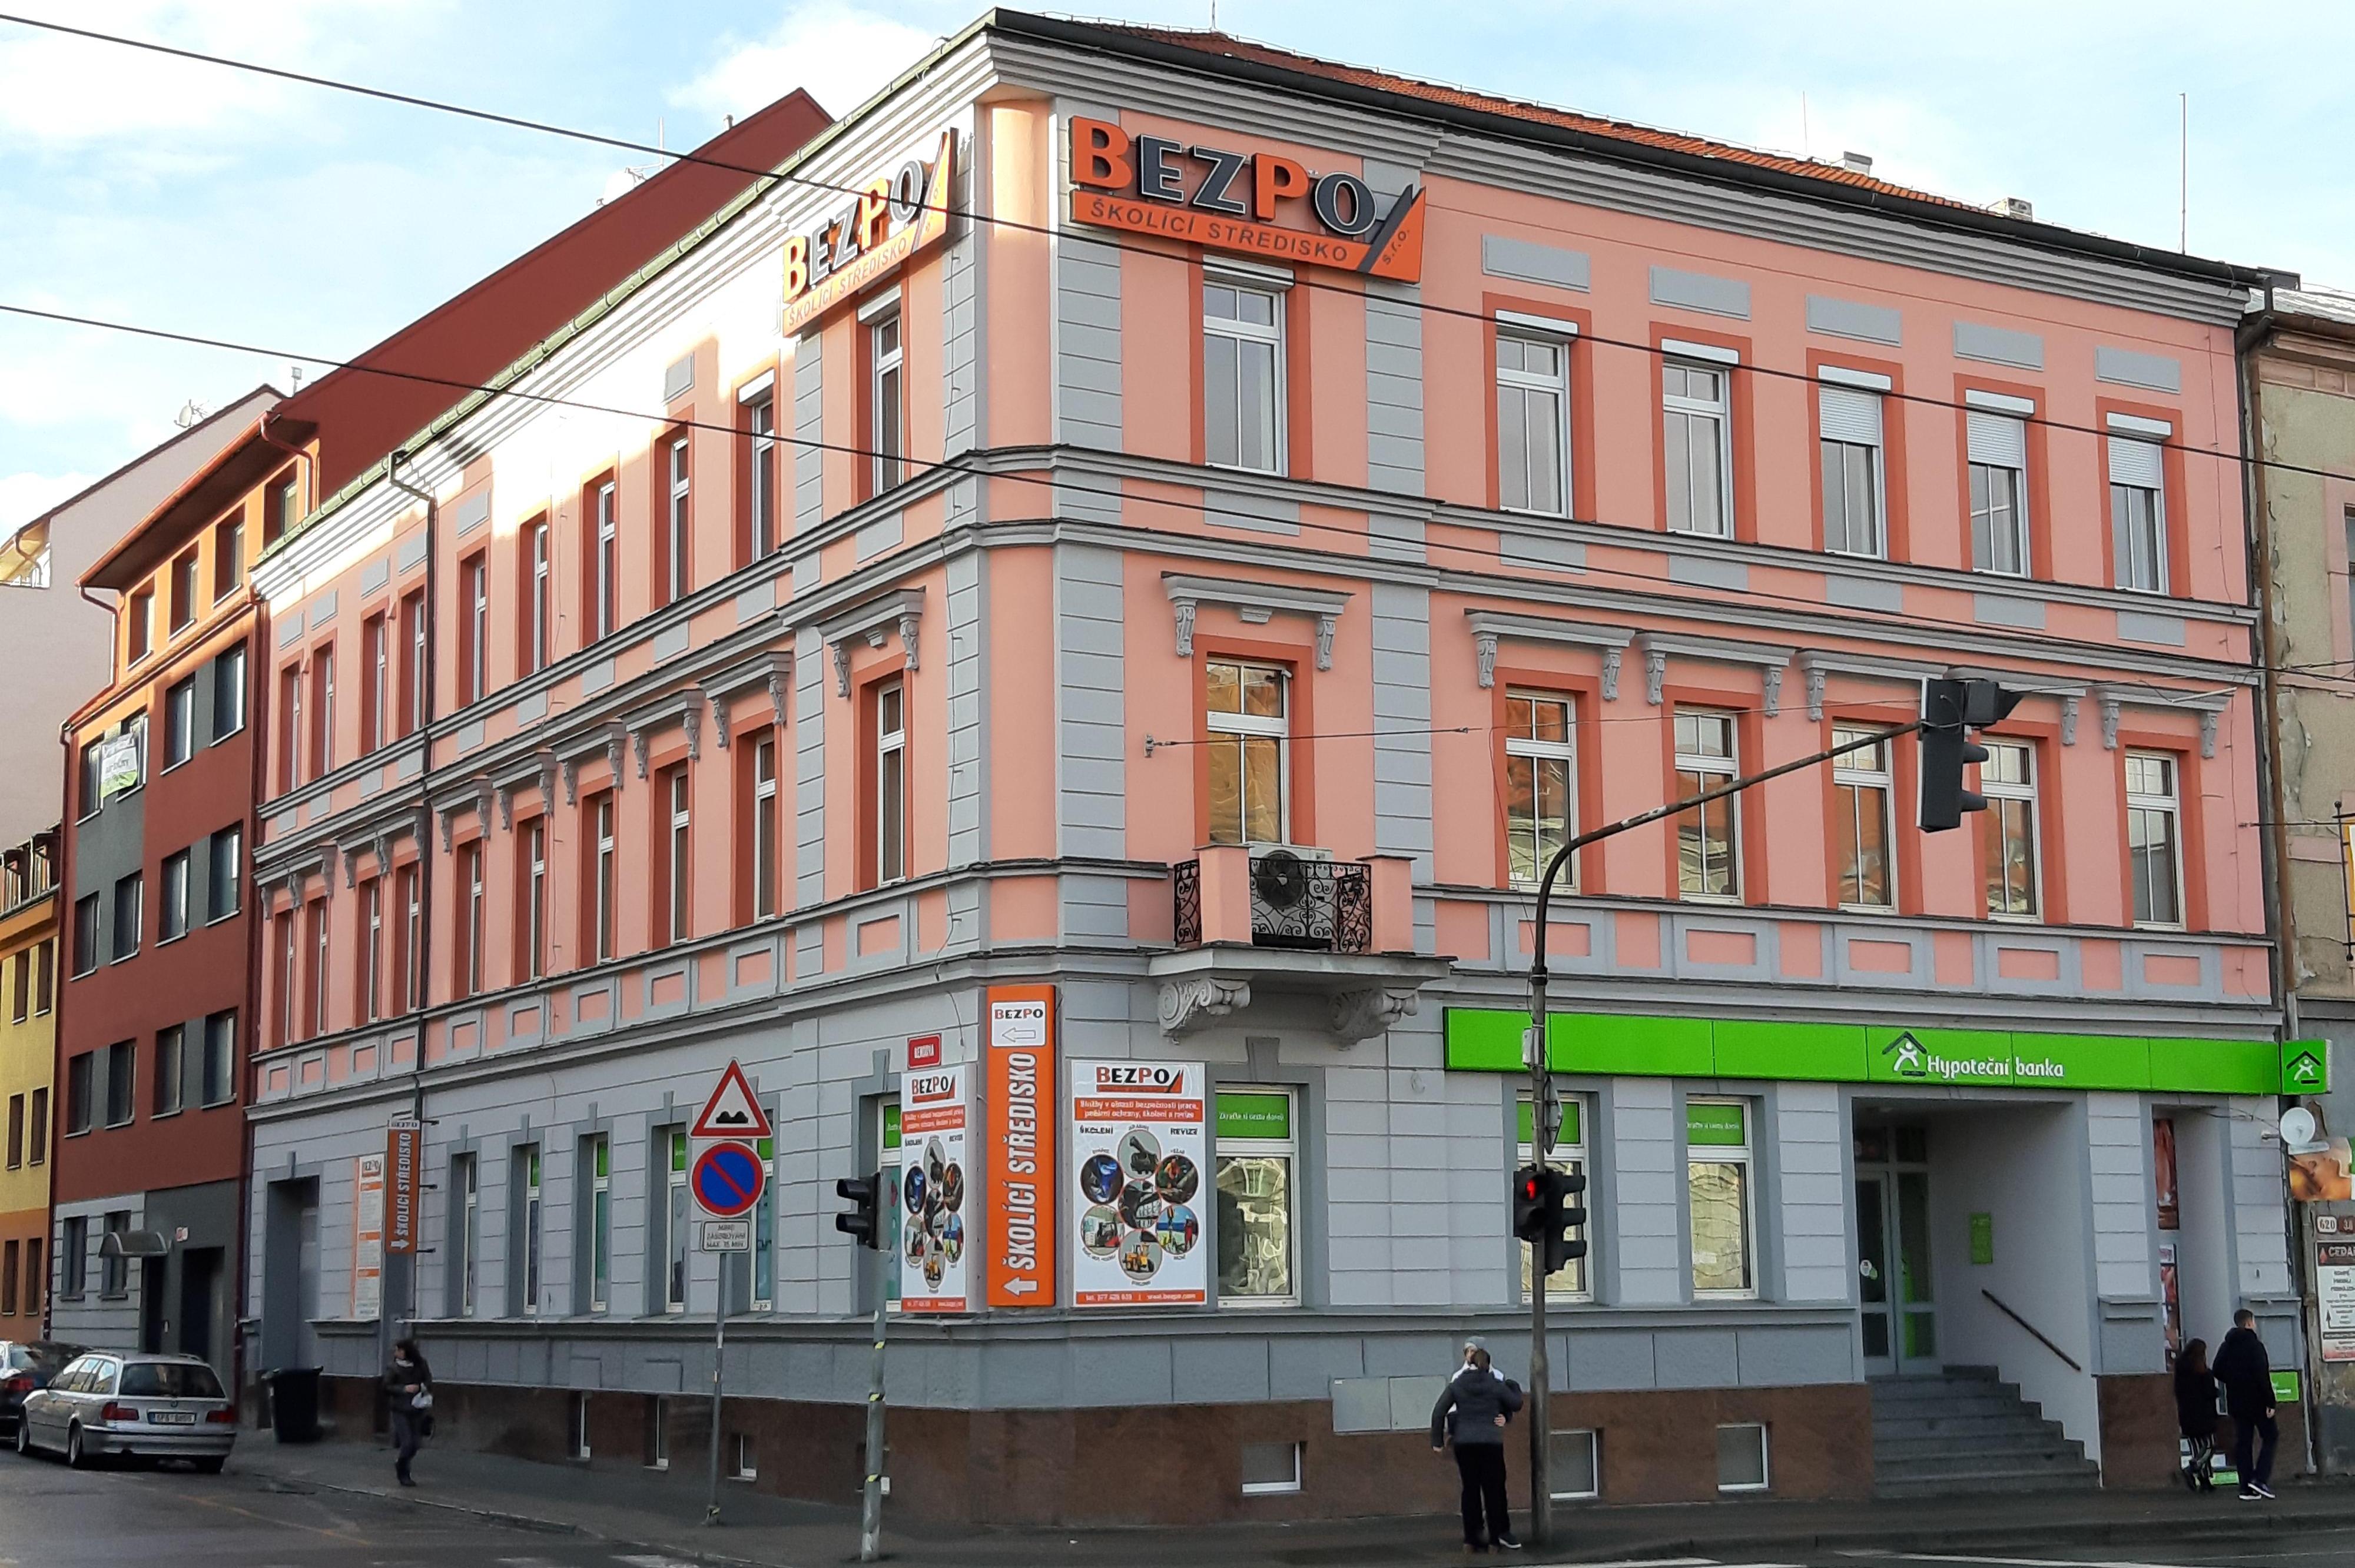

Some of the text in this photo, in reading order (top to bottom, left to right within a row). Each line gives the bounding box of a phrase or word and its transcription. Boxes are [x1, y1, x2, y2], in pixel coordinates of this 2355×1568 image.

[1069, 115, 1378, 235] BEZPO
[784, 160, 923, 304] BEZPO
[1090, 197, 1348, 262] ŠKOLÍCÍ STŘEDISKO
[839, 237, 906, 294] STŘEDISKO
[994, 1008, 1043, 1019] BEZPO
[912, 1076, 948, 1094] BEZPO
[1096, 1067, 1169, 1084] BEZPO
[1927, 1055, 2064, 1079] Hypoteční banka
[1002, 1052, 1036, 1174] STŘEDISKO
[1002, 1179, 1036, 1271] ŠKOLÍCÍ
[2320, 1219, 2336, 1230] 620
